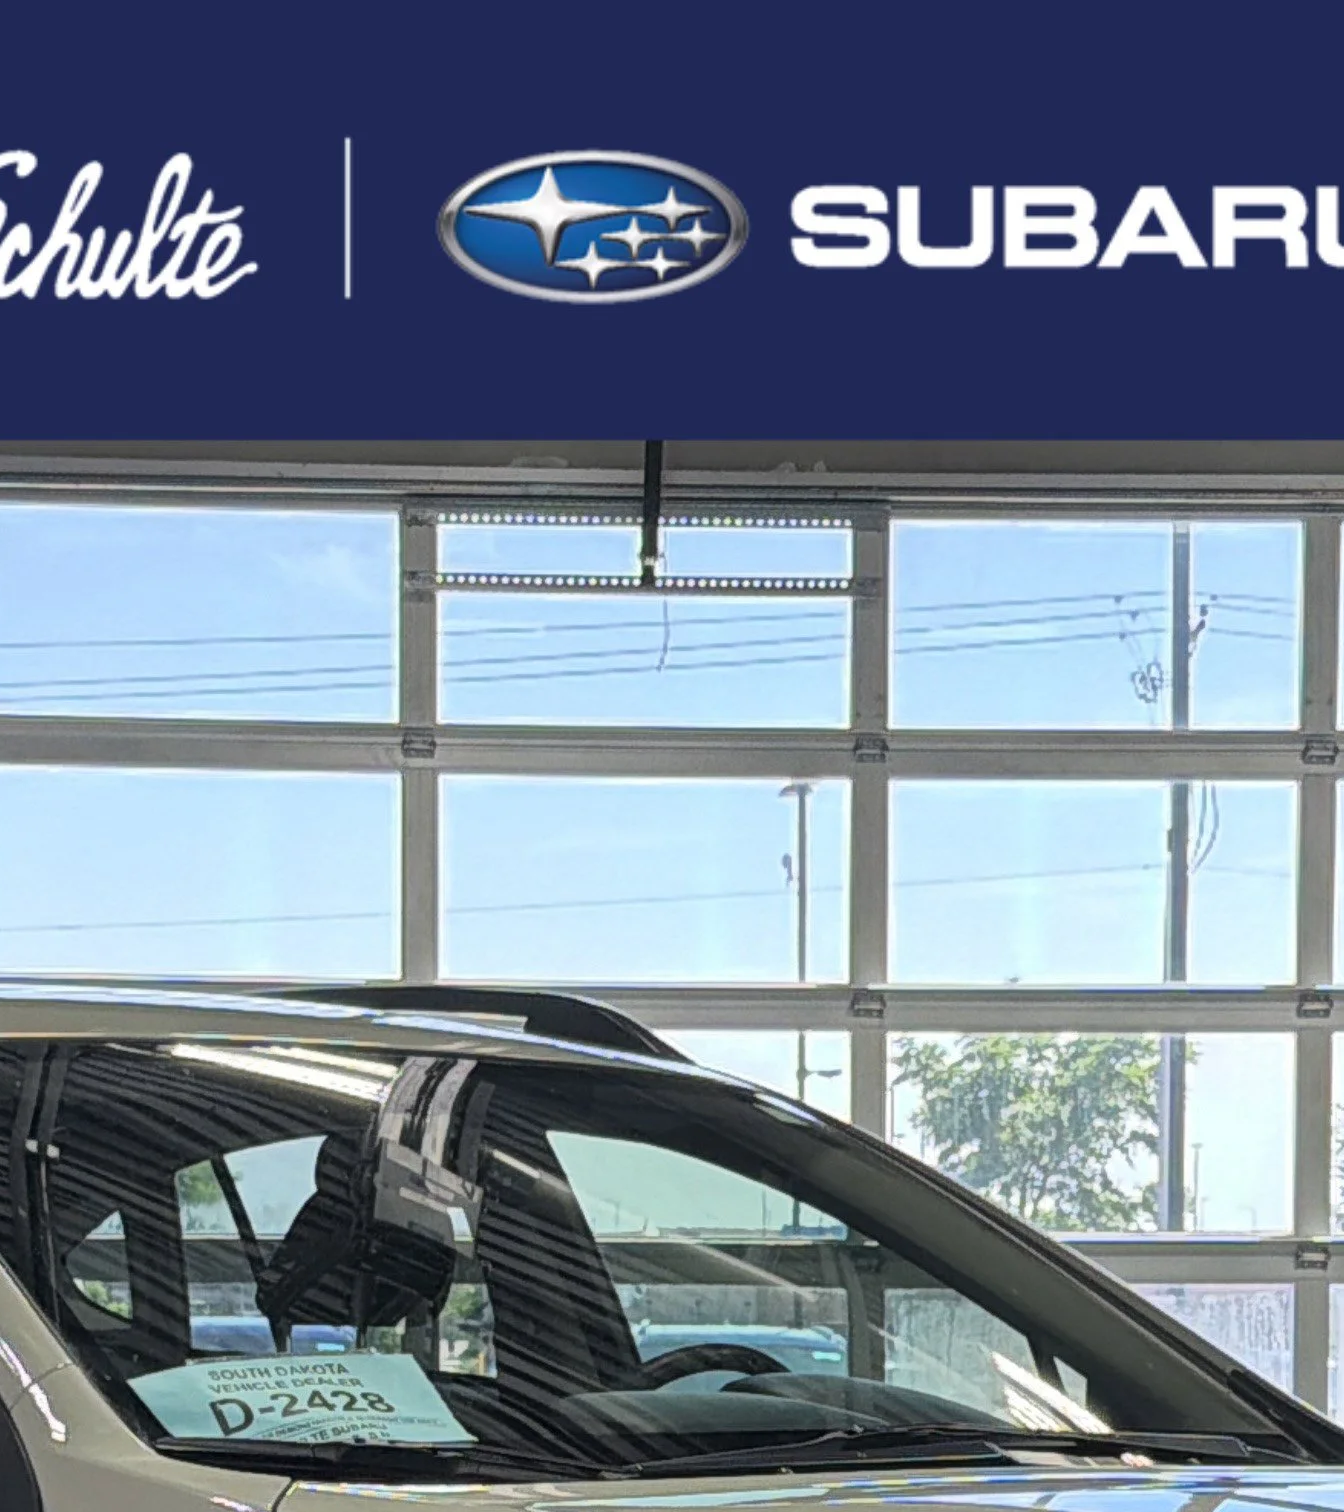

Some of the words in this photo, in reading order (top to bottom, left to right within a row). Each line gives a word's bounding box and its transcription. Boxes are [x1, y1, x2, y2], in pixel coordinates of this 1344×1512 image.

[207, 1366, 272, 1381] SOUTH
[273, 1362, 350, 1377] DAKOTA
[207, 1379, 290, 1394] VEHICLE
[291, 1376, 365, 1389] DEALER
[208, 1389, 396, 1437] D-2428
